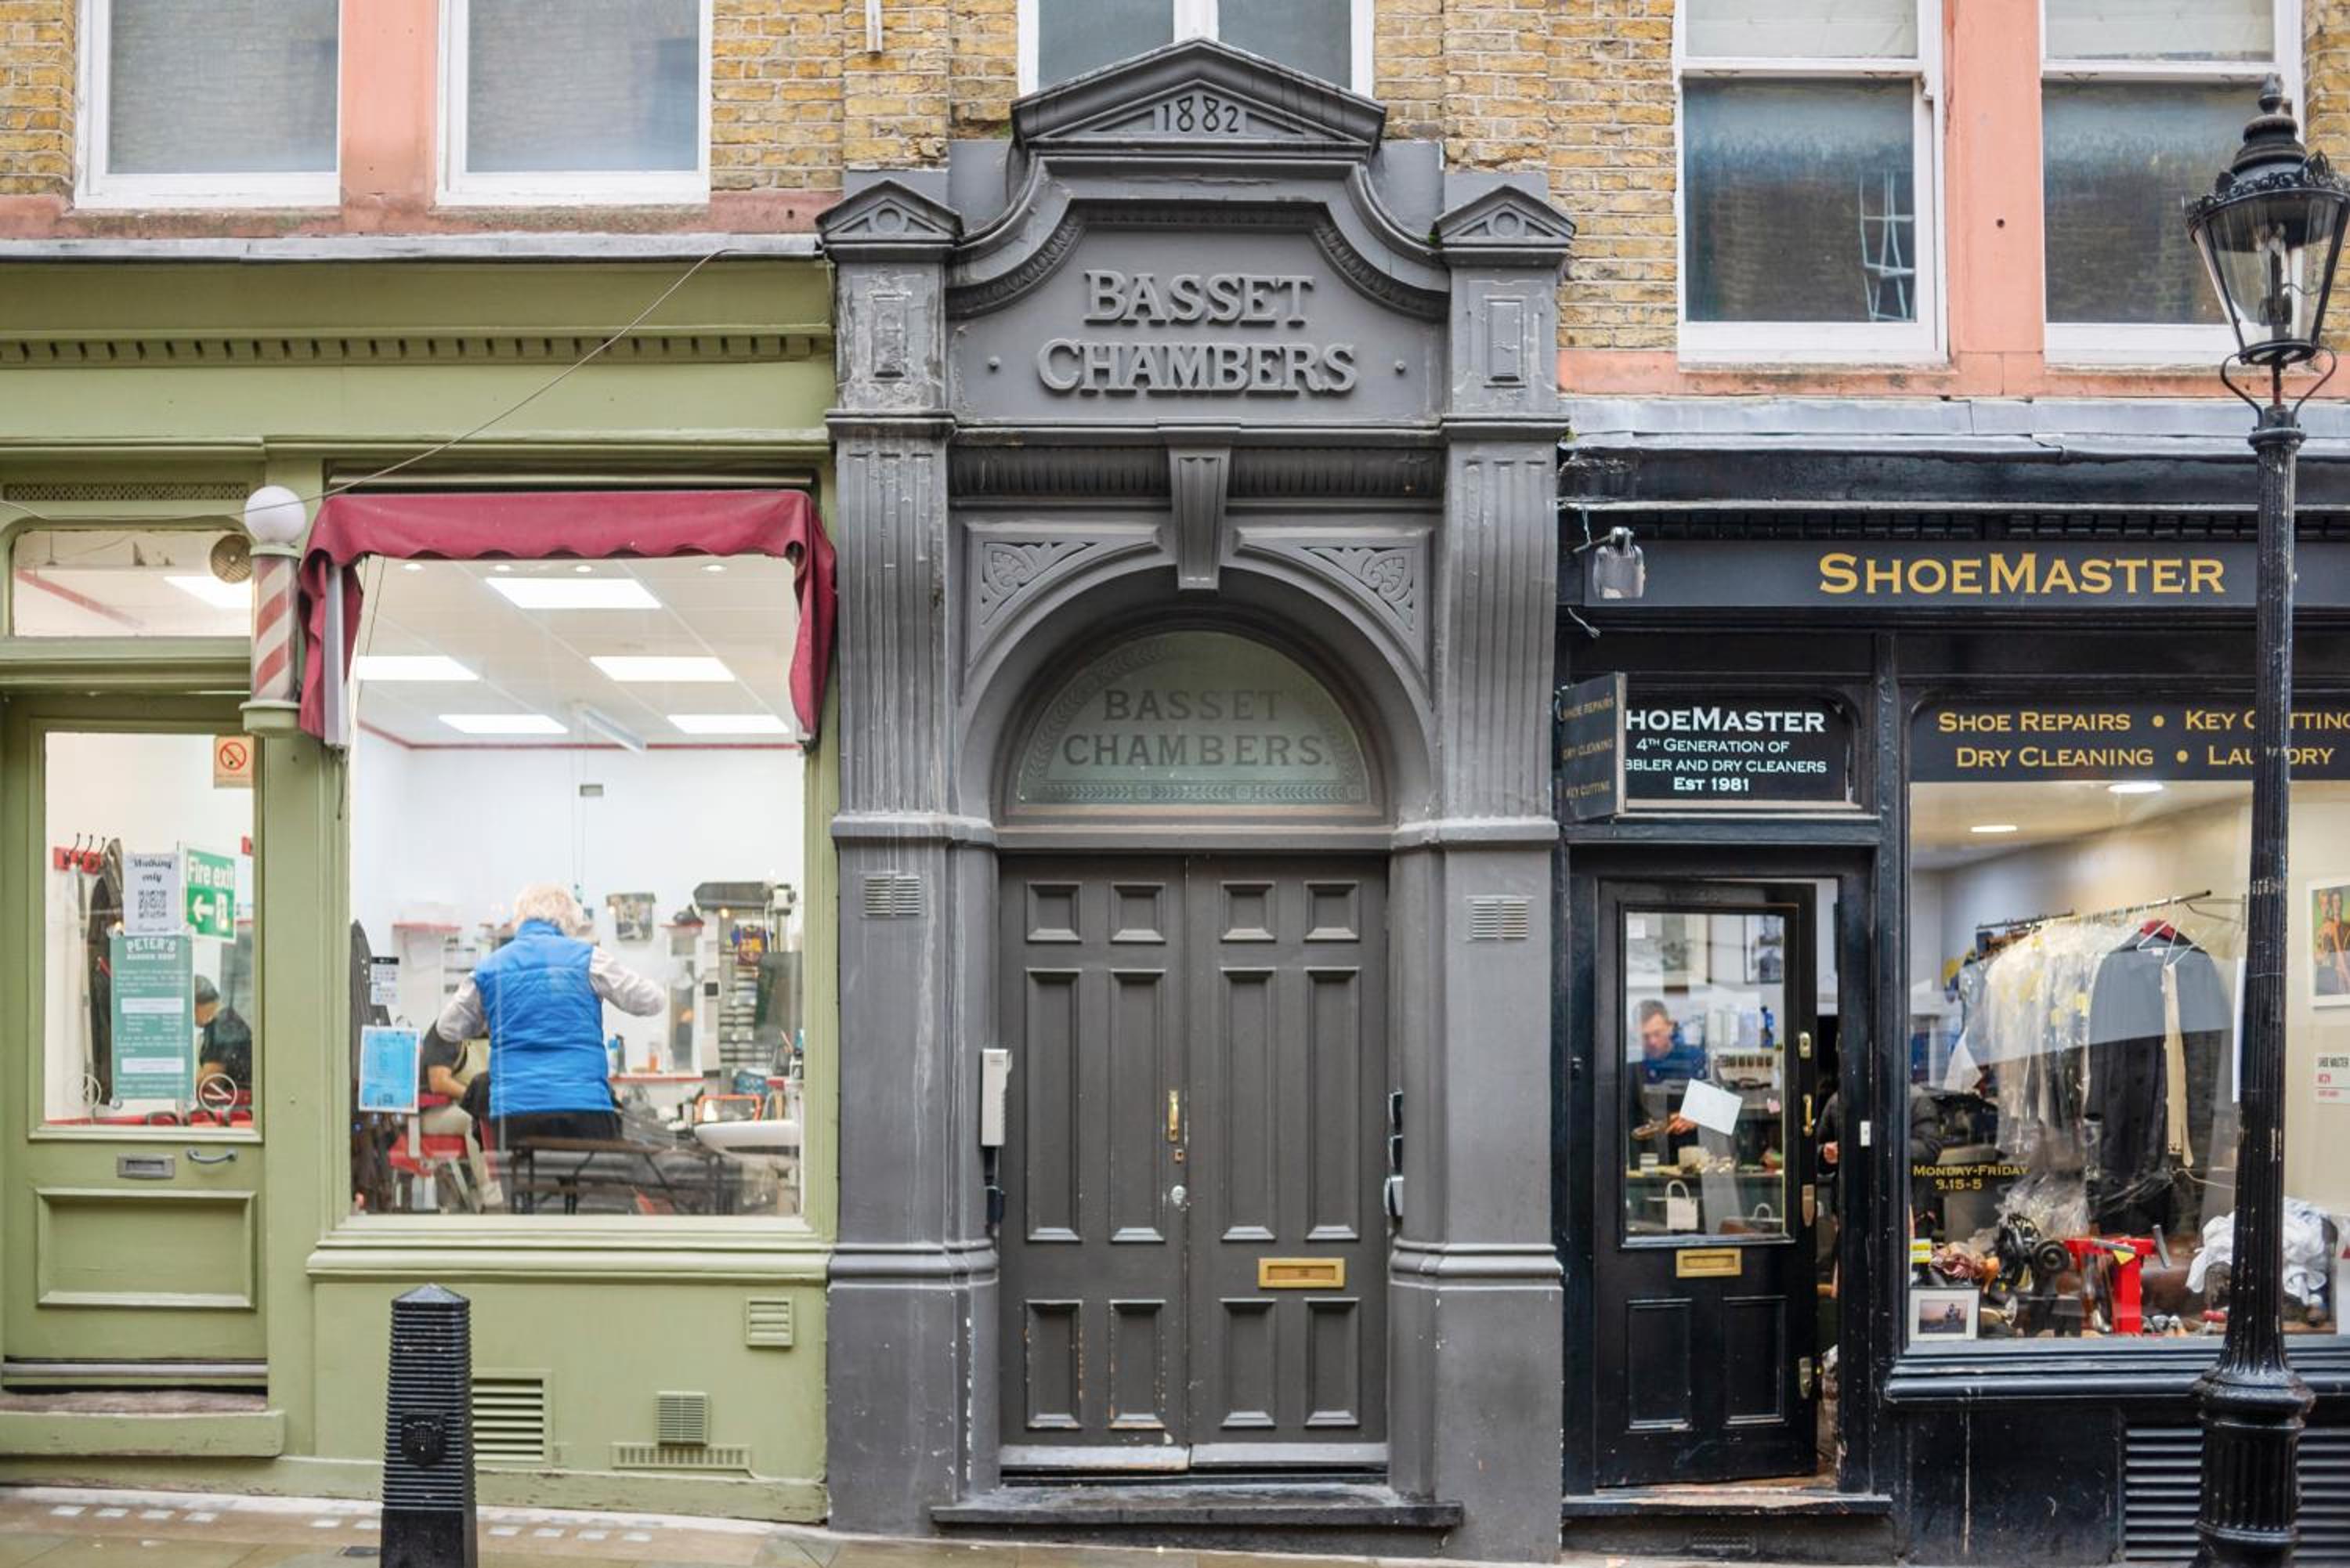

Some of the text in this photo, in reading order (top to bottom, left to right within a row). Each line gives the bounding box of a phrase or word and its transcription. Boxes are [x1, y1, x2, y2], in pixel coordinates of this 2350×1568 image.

[1163, 95, 1238, 133] 1882
[1084, 269, 1316, 326] BASSET
[1036, 338, 1358, 397] CHAMBERS
[1820, 553, 2225, 594] SHOEMASTER
[1104, 689, 1285, 721] BASSET
[1625, 706, 1826, 732] HOEMASTER
[1938, 711, 2012, 732] SHOE
[2020, 711, 2131, 732] REPAIRS
[2186, 710, 2236, 730] KEY
[1636, 737, 1790, 753] 4TH GENERATION OF
[1956, 746, 2012, 768] DRY
[2019, 746, 2153, 768] CLEANING
[1625, 759, 1828, 773] BBLER AND DRY CLEANERS
[1673, 776, 1750, 791] EST 1981
[187, 856, 235, 890] Fire exit
[126, 938, 175, 953] PETER'S
[1913, 1165, 2030, 1176] MONDAY-FRIDAY
